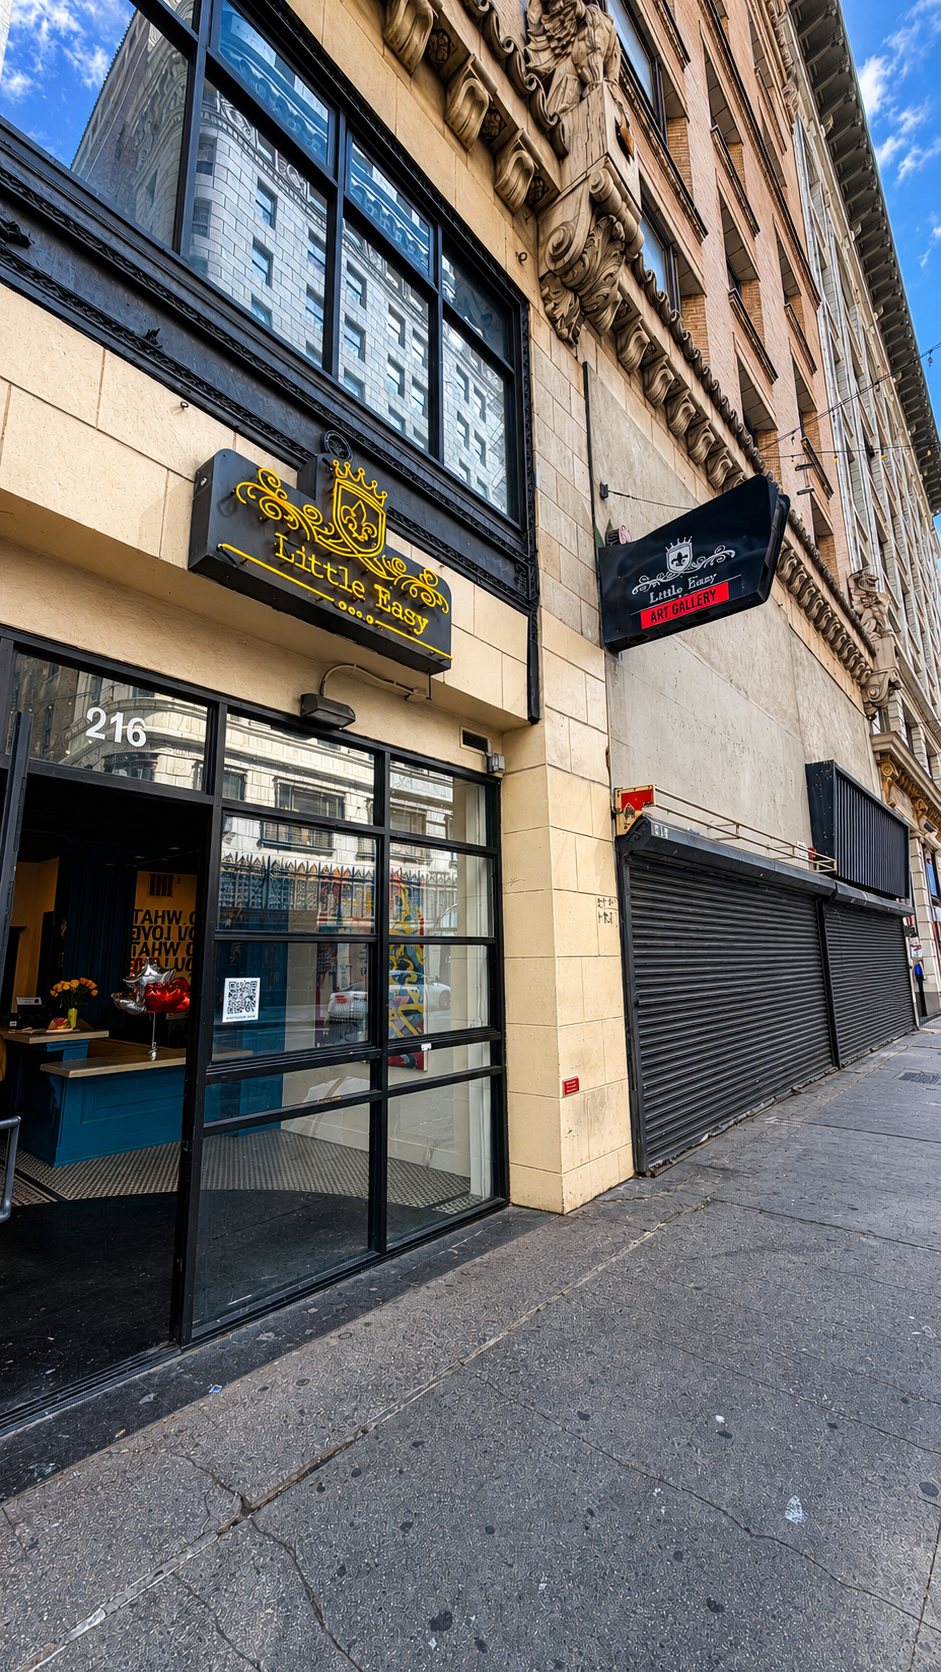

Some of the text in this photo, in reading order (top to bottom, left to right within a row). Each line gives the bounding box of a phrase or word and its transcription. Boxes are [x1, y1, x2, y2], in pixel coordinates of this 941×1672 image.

[275, 532, 429, 635] Little Easy
[649, 585, 684, 604] Little
[651, 589, 717, 623] ART GALLERY
[85, 706, 147, 748] 216
